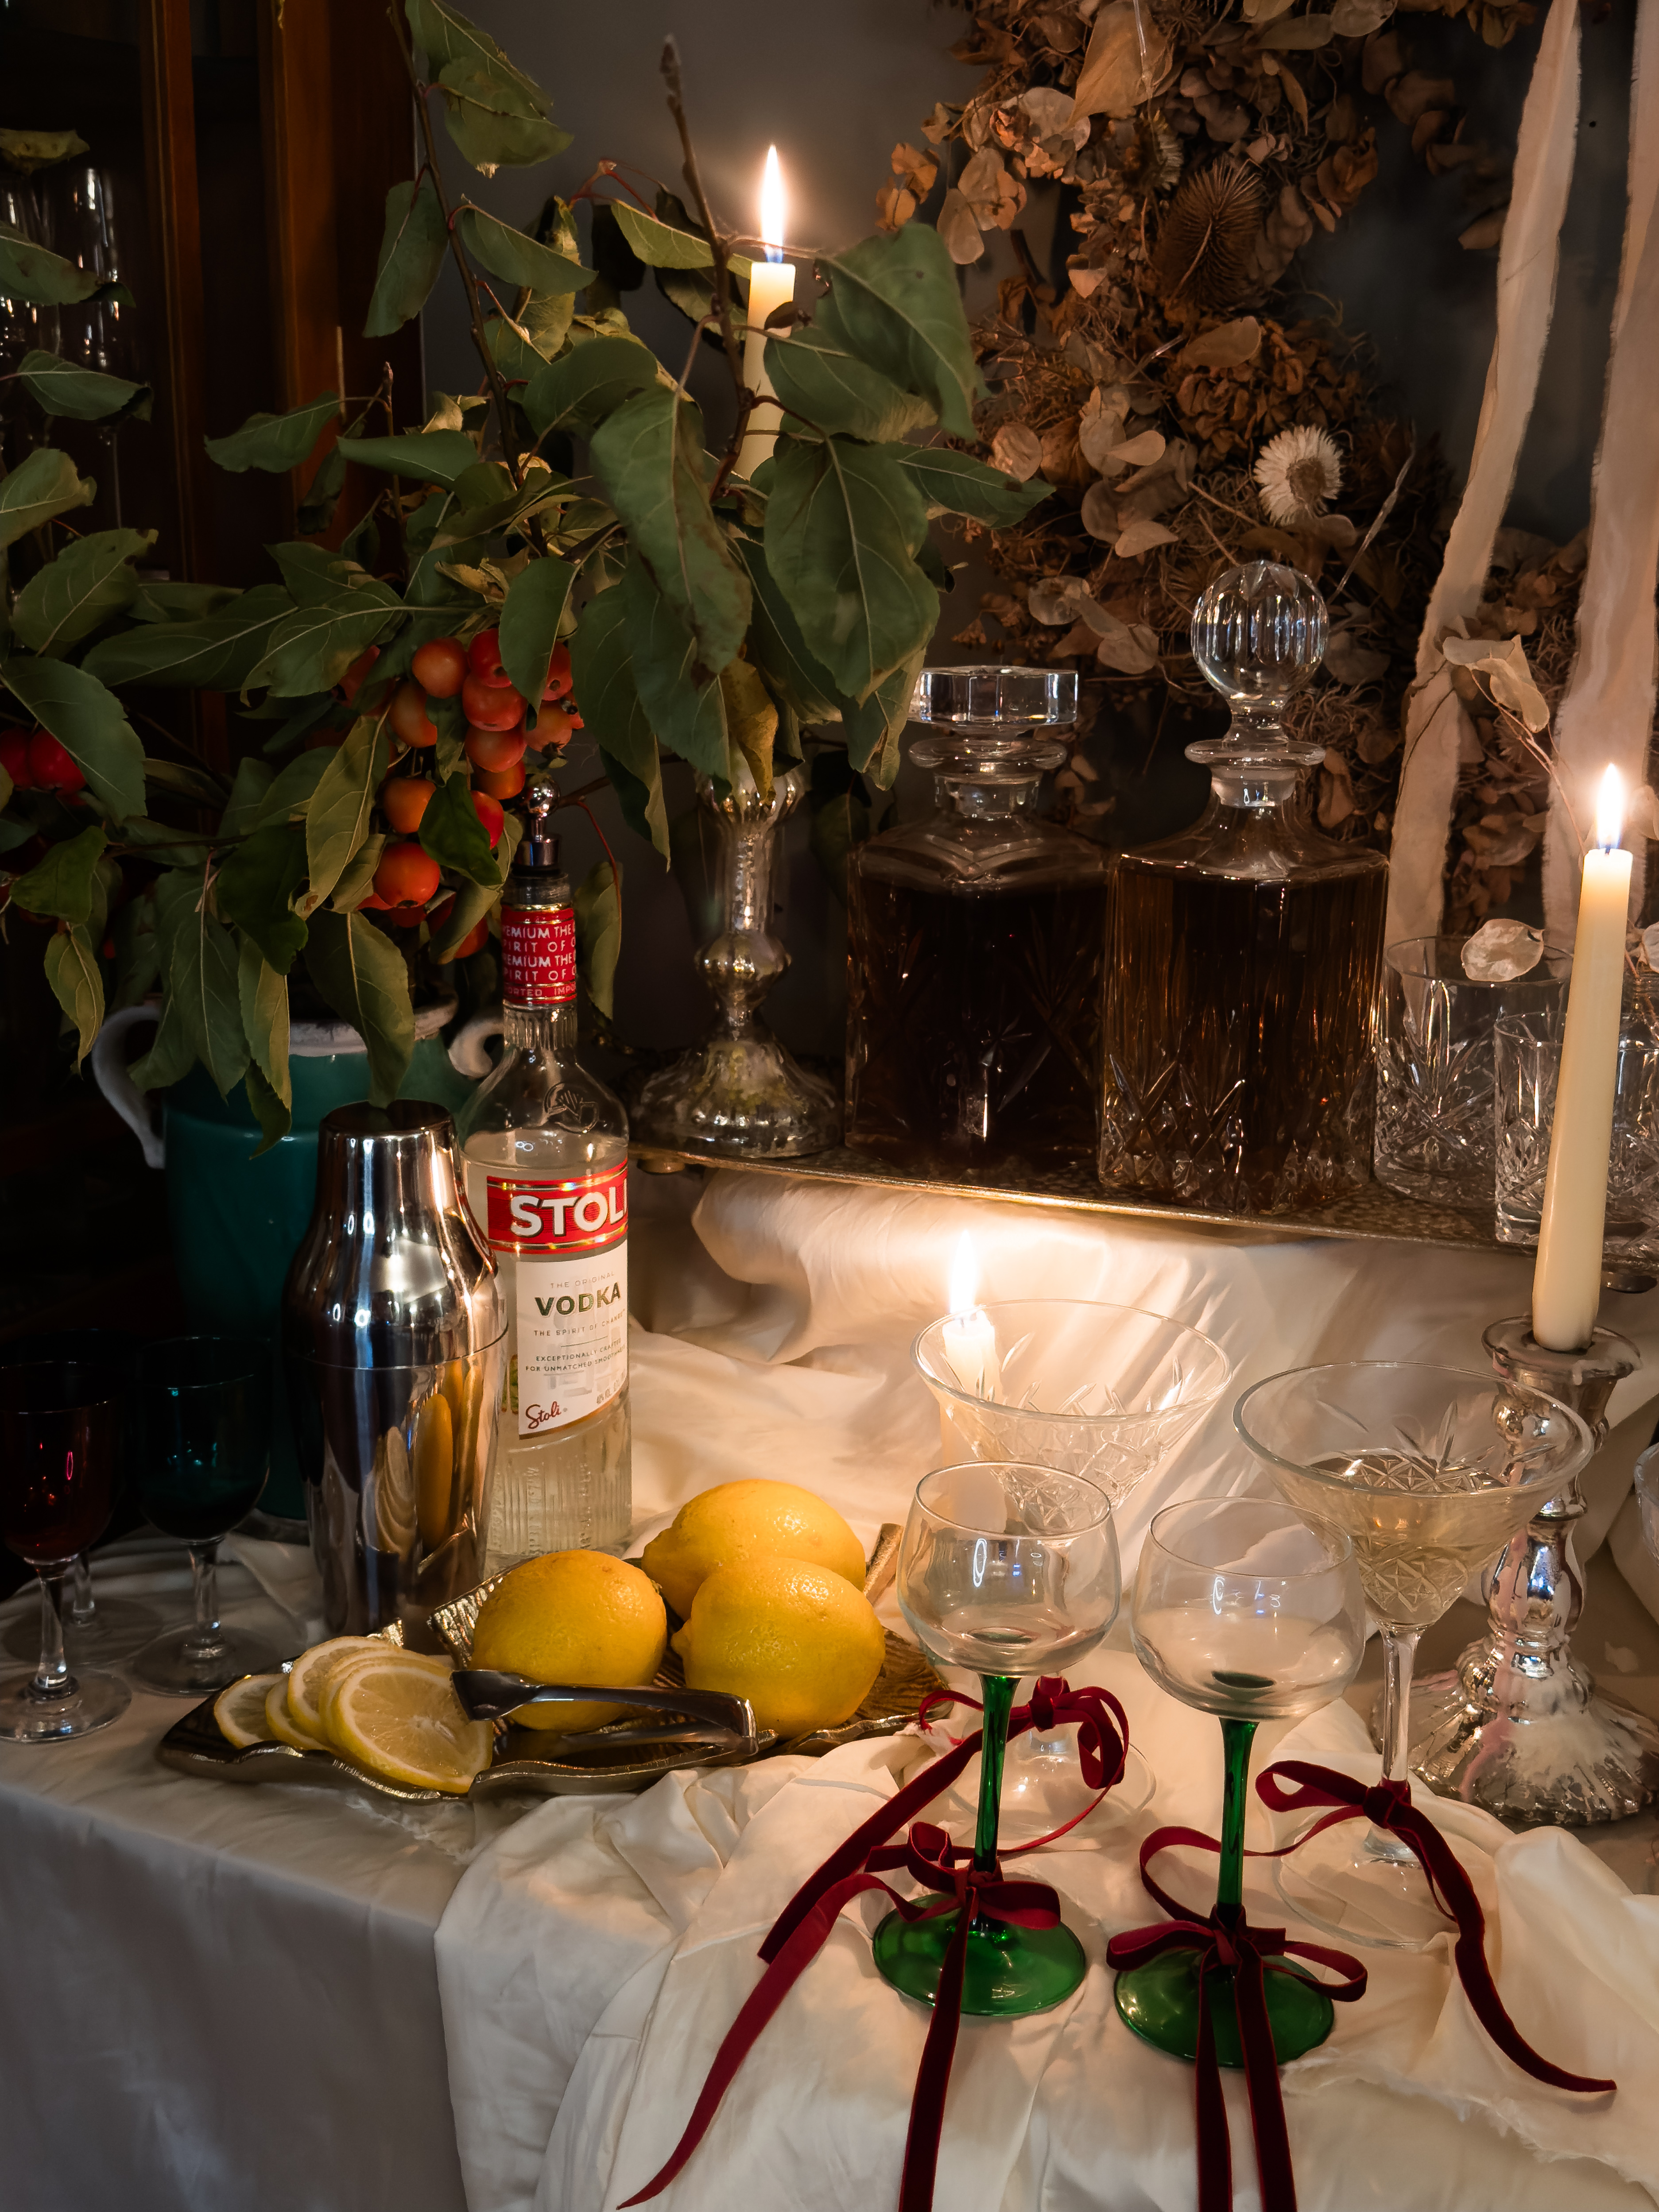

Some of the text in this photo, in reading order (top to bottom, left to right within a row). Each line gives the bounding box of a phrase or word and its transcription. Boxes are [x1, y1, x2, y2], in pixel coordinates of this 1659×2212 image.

[554, 924, 571, 938] THE
[547, 940, 566, 952] OF
[554, 952, 572, 967] THE
[548, 968, 566, 981] OF
[575, 1271, 614, 1286] ORIGINAL
[535, 1282, 621, 1316] VODKA
[556, 1326, 585, 1336] SPIRIT
[536, 1349, 597, 1361] EXCEPTIONALLY
[544, 1361, 592, 1372] UNMATCHED
[525, 1401, 562, 1429] Stoli
